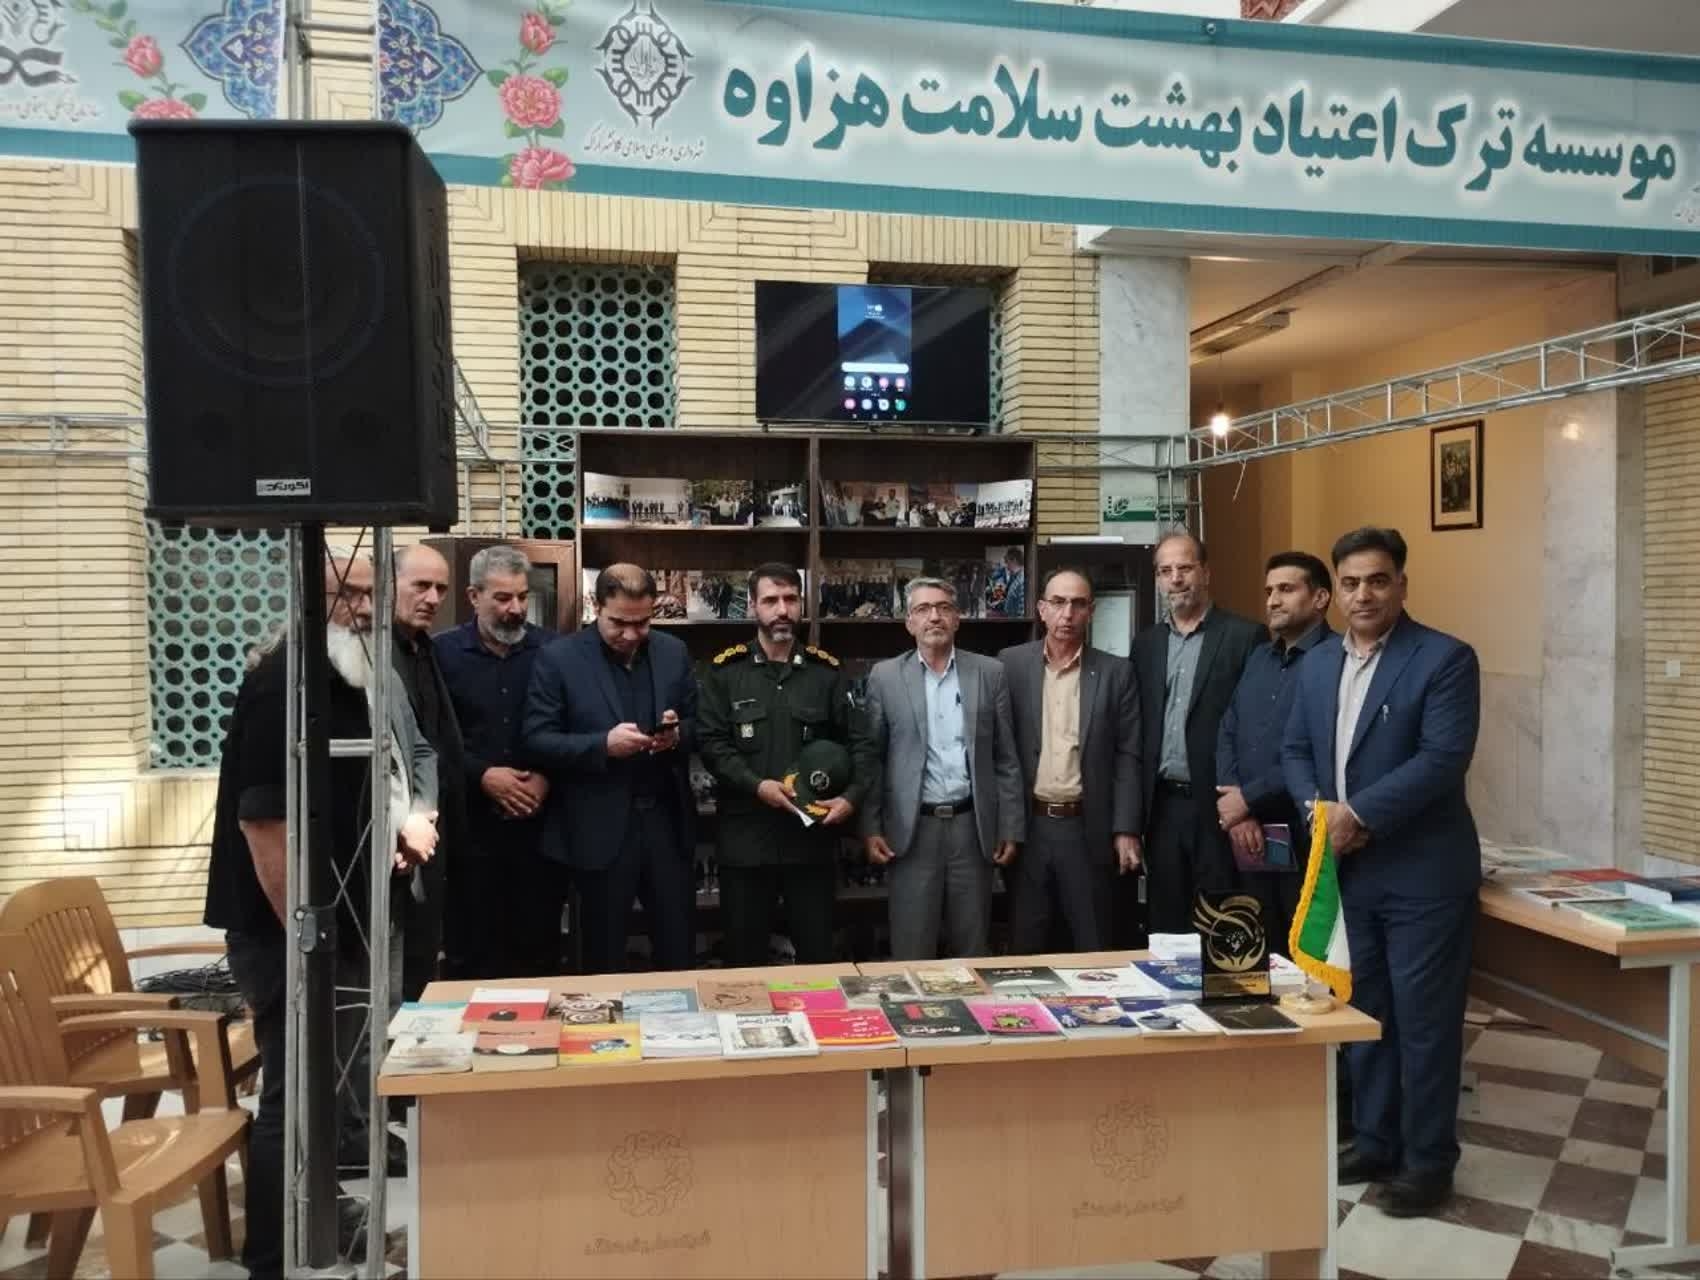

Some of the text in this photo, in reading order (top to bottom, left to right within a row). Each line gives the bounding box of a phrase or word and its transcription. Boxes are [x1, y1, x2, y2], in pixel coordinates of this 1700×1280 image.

[723, 50, 1676, 200] موسسه ترک اعتیاد بهشت سلامت هزاوه
